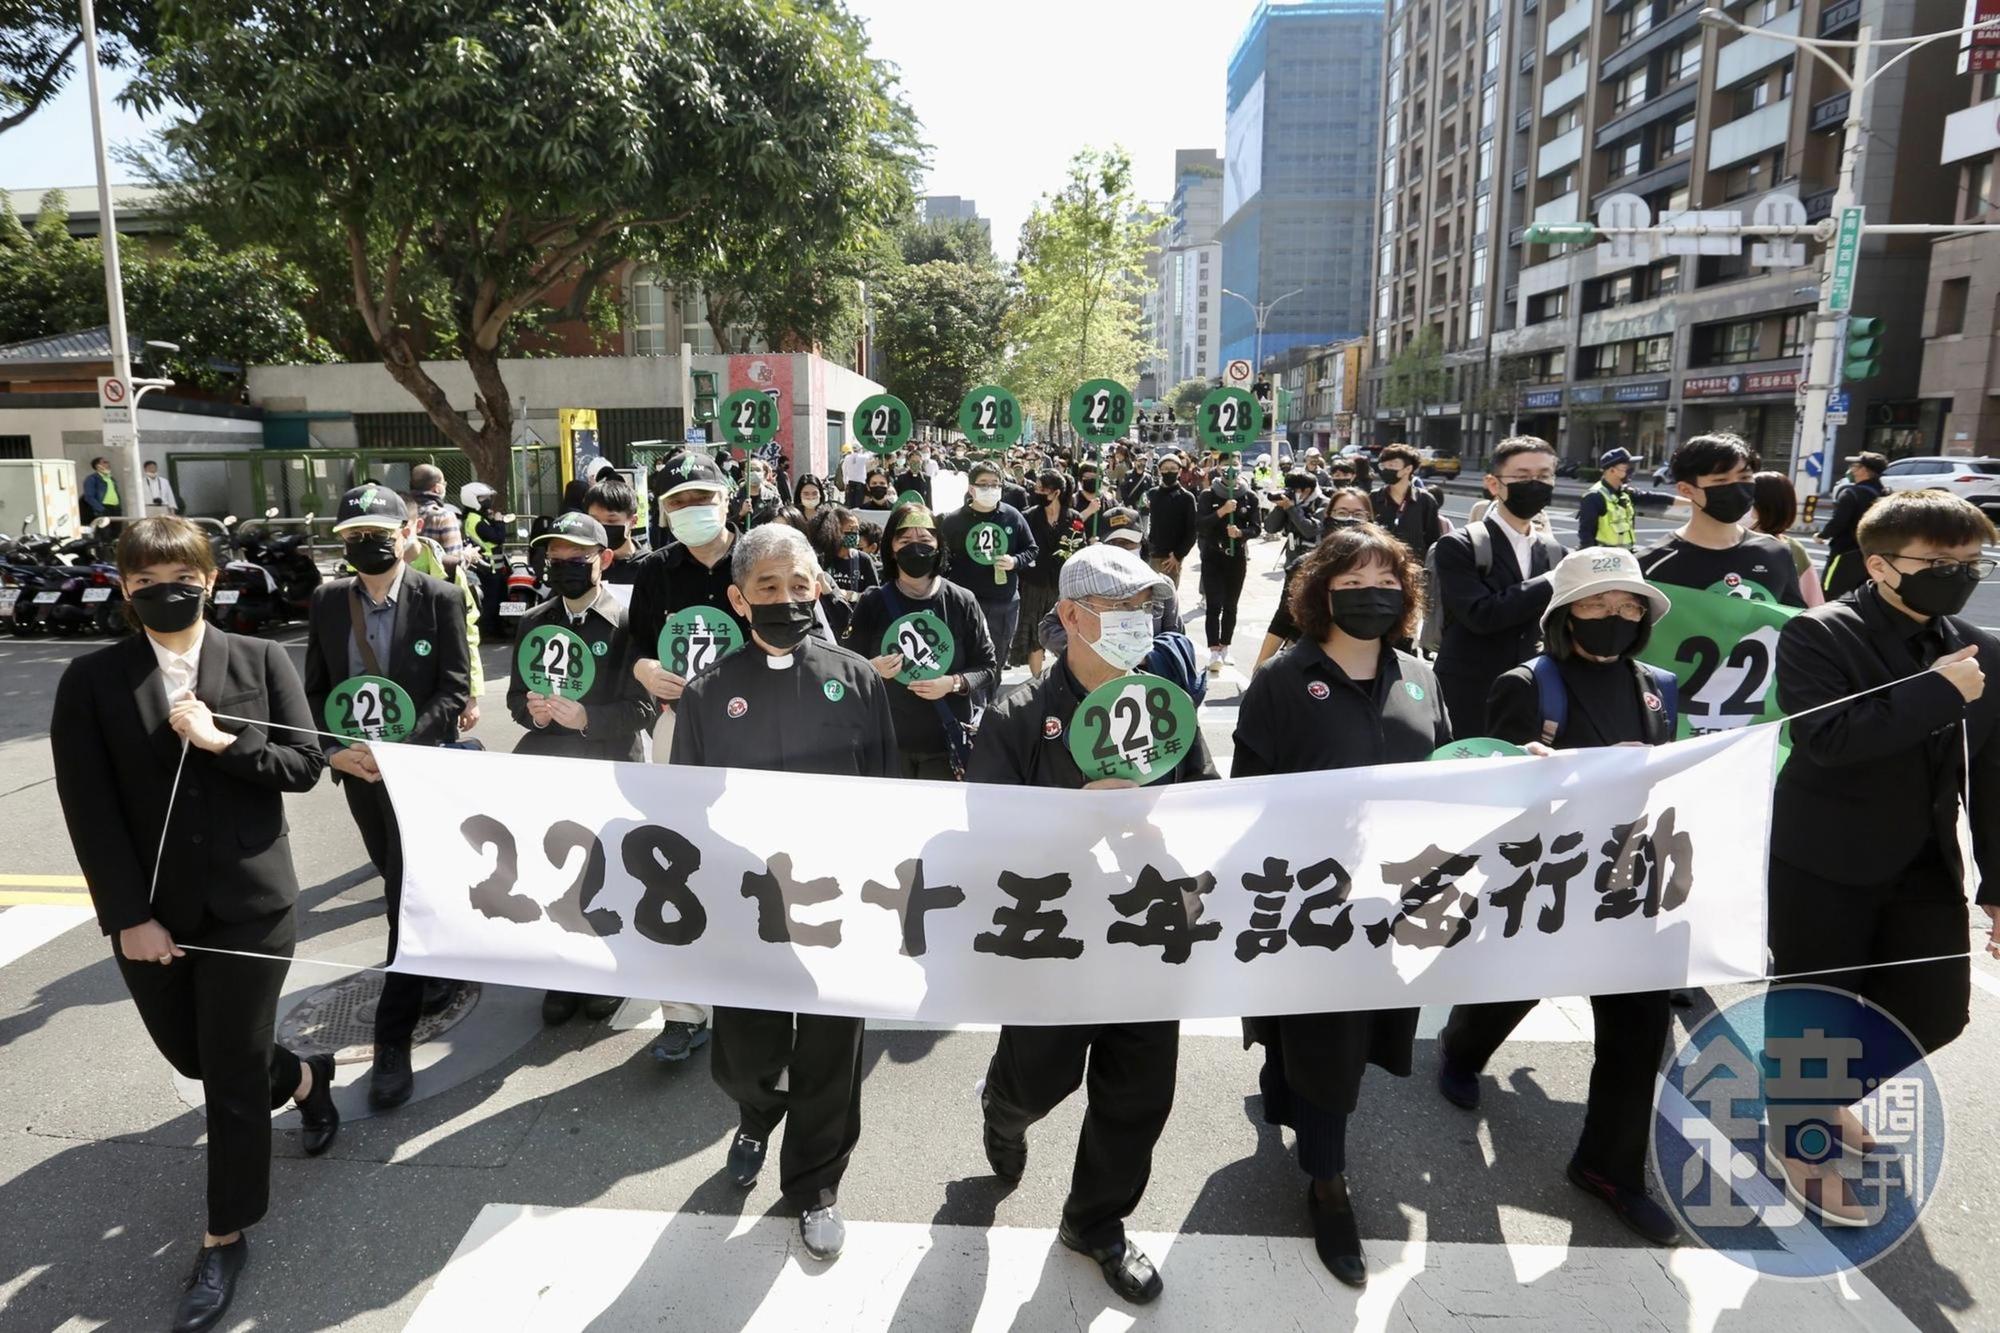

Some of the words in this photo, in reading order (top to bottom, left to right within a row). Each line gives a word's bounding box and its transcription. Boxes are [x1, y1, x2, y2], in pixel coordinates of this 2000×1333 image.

[731, 400, 771, 429] 228
[861, 408, 901, 436] 228
[971, 400, 1013, 430] 228
[1082, 394, 1125, 424] 228
[1208, 401, 1252, 433] 228
[972, 529, 1001, 550] 228
[529, 636, 583, 678] 228
[529, 672, 583, 692] 七十五年
[336, 687, 401, 728] 228
[1084, 687, 1177, 760] 228
[1097, 738, 1183, 776] 七十五年
